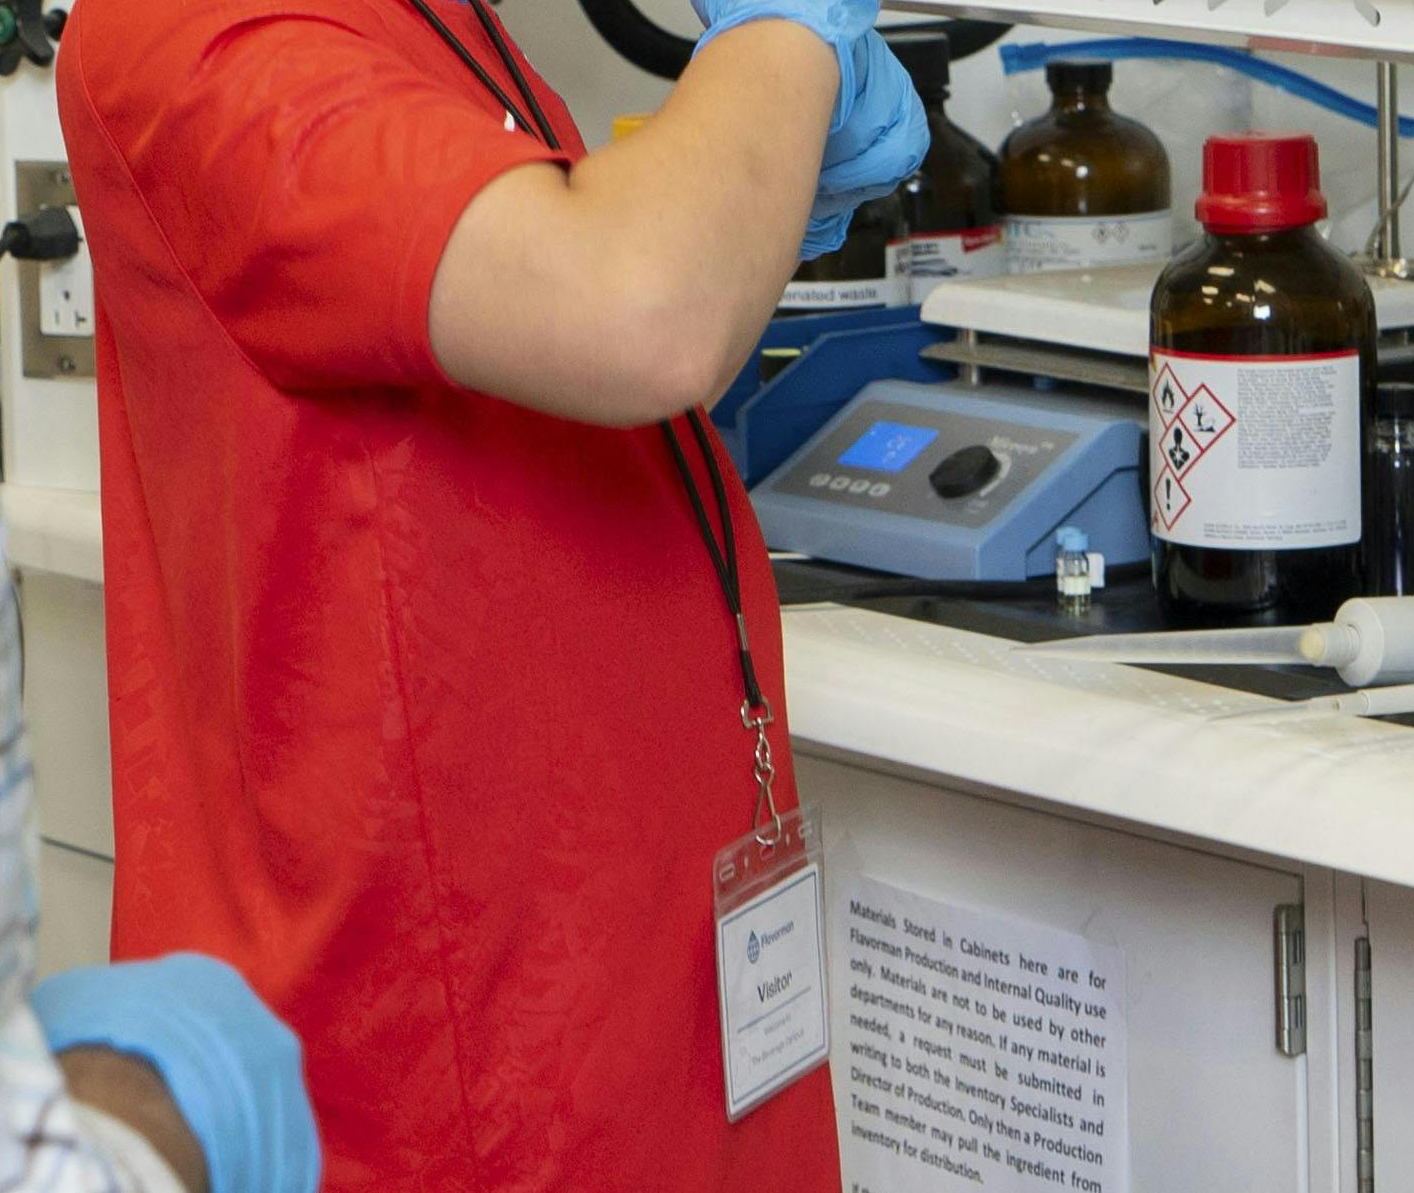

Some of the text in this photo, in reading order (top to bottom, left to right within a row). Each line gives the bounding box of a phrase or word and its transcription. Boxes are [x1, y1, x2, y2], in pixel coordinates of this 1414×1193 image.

[757, 970, 792, 1003] Visitor
[850, 900, 896, 929] Materials
[904, 918, 936, 943] Stored
[960, 938, 1010, 965] Cabinets
[1019, 952, 1048, 976] here
[1058, 967, 1079, 983] are
[1089, 969, 1106, 990] for
[850, 927, 1107, 1019] Flavorman Production and Internal Quality use
[850, 984, 1106, 1078] departments for any reason. If any material is
[880, 965, 926, 996] Materials
[931, 986, 948, 1003] are
[952, 994, 970, 1011] not
[975, 1000, 987, 1016] to
[992, 1004, 1006, 1022] be
[1013, 1012, 1043, 1032] used
[1049, 1018, 1064, 1041] by
[1070, 1027, 1106, 1048] other
[850, 1042, 1104, 1137] writing to both the Inventory Specialists and
[850, 1066, 892, 1092] Director
[894, 1083, 905, 1098] of
[907, 1086, 966, 1122] Production.
[969, 1109, 993, 1134] Only
[996, 1119, 1021, 1141] then
[1034, 1131, 1103, 1166] Production
[913, 1036, 953, 1061] request
[959, 1053, 986, 1073] must
[994, 1061, 1008, 1081] be
[1018, 1072, 1082, 1101] submitted
[1093, 1089, 1105, 1107] in
[851, 1093, 1103, 1193] Team member may pull the ingredient from
[903, 1139, 917, 1159] for
